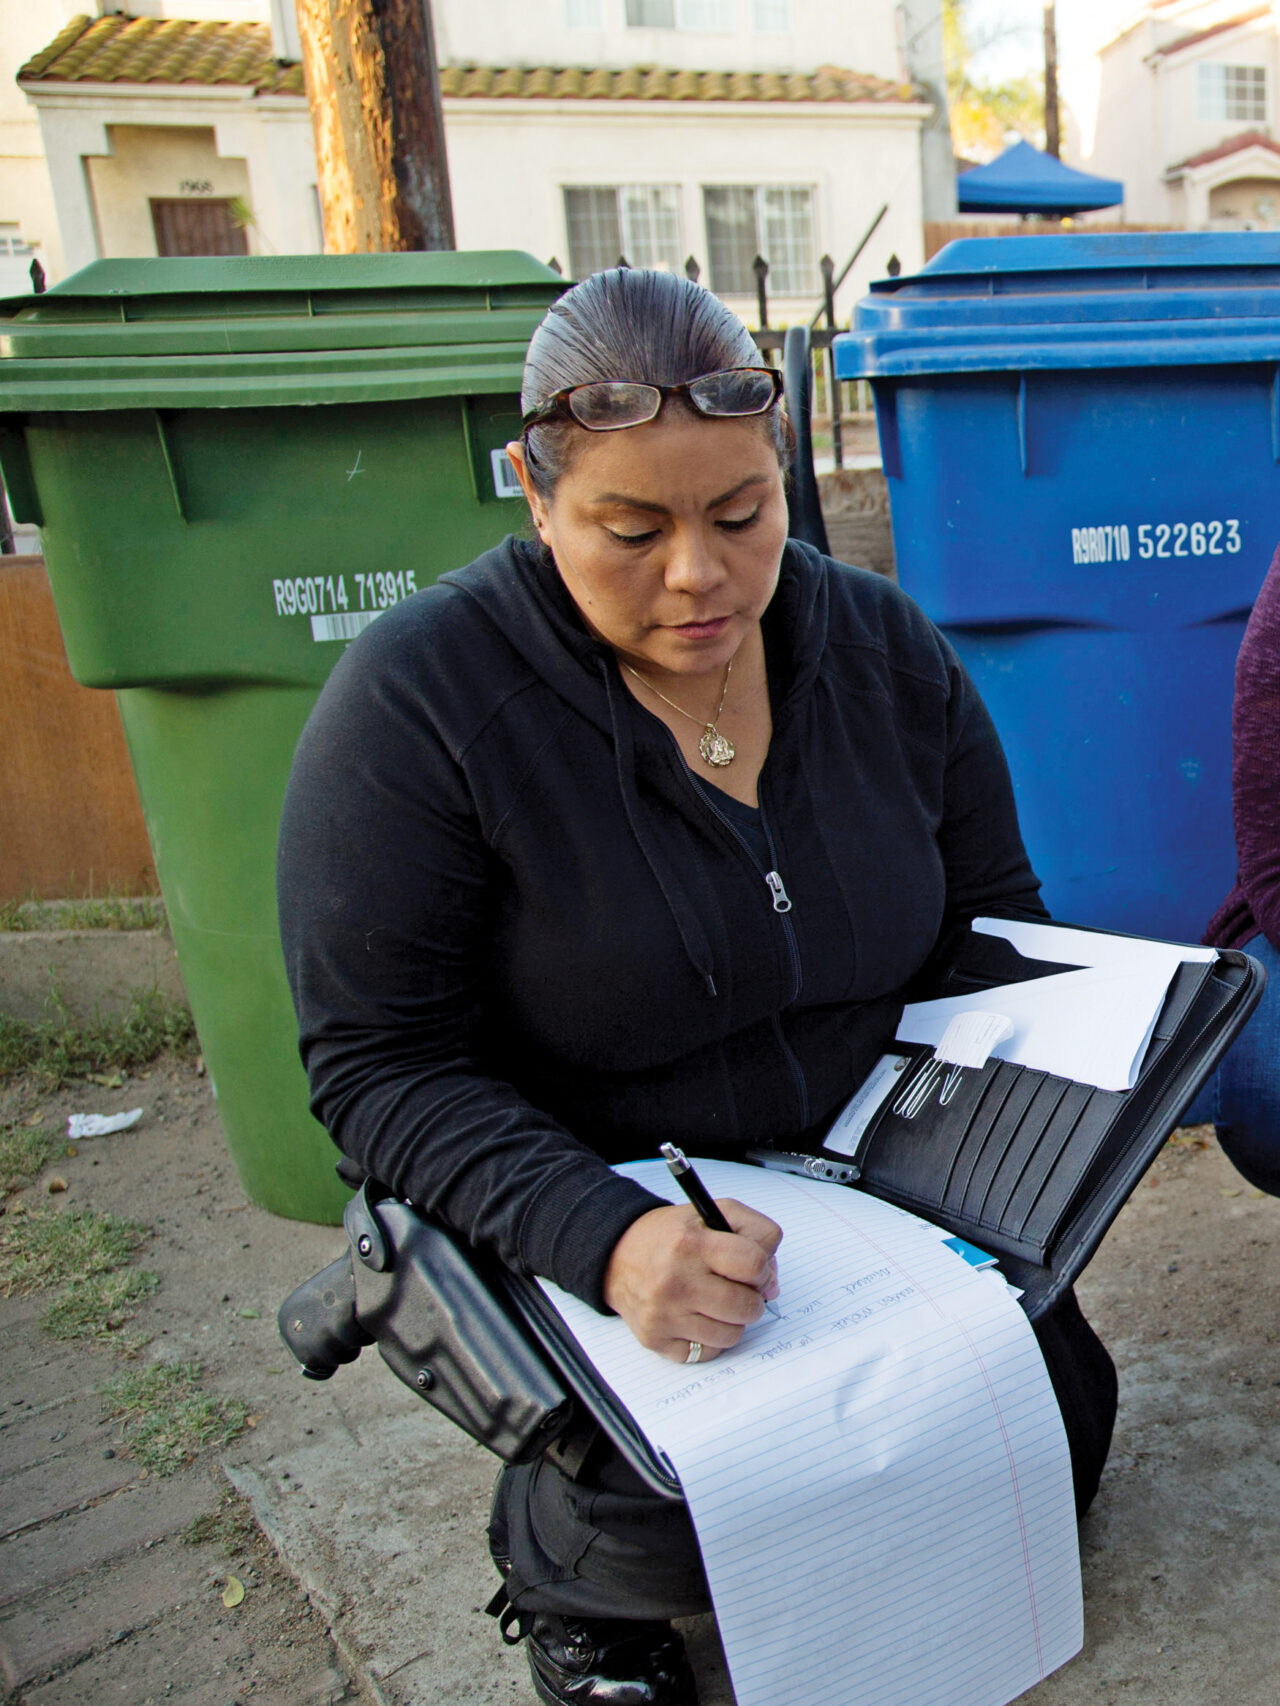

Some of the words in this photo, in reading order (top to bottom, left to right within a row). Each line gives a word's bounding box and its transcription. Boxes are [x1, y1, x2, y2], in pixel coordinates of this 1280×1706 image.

[1071, 524, 1131, 565] R9R0710
[1138, 519, 1242, 559] 522623
[273, 574, 348, 616] R9G0714
[354, 570, 418, 609] 713915
